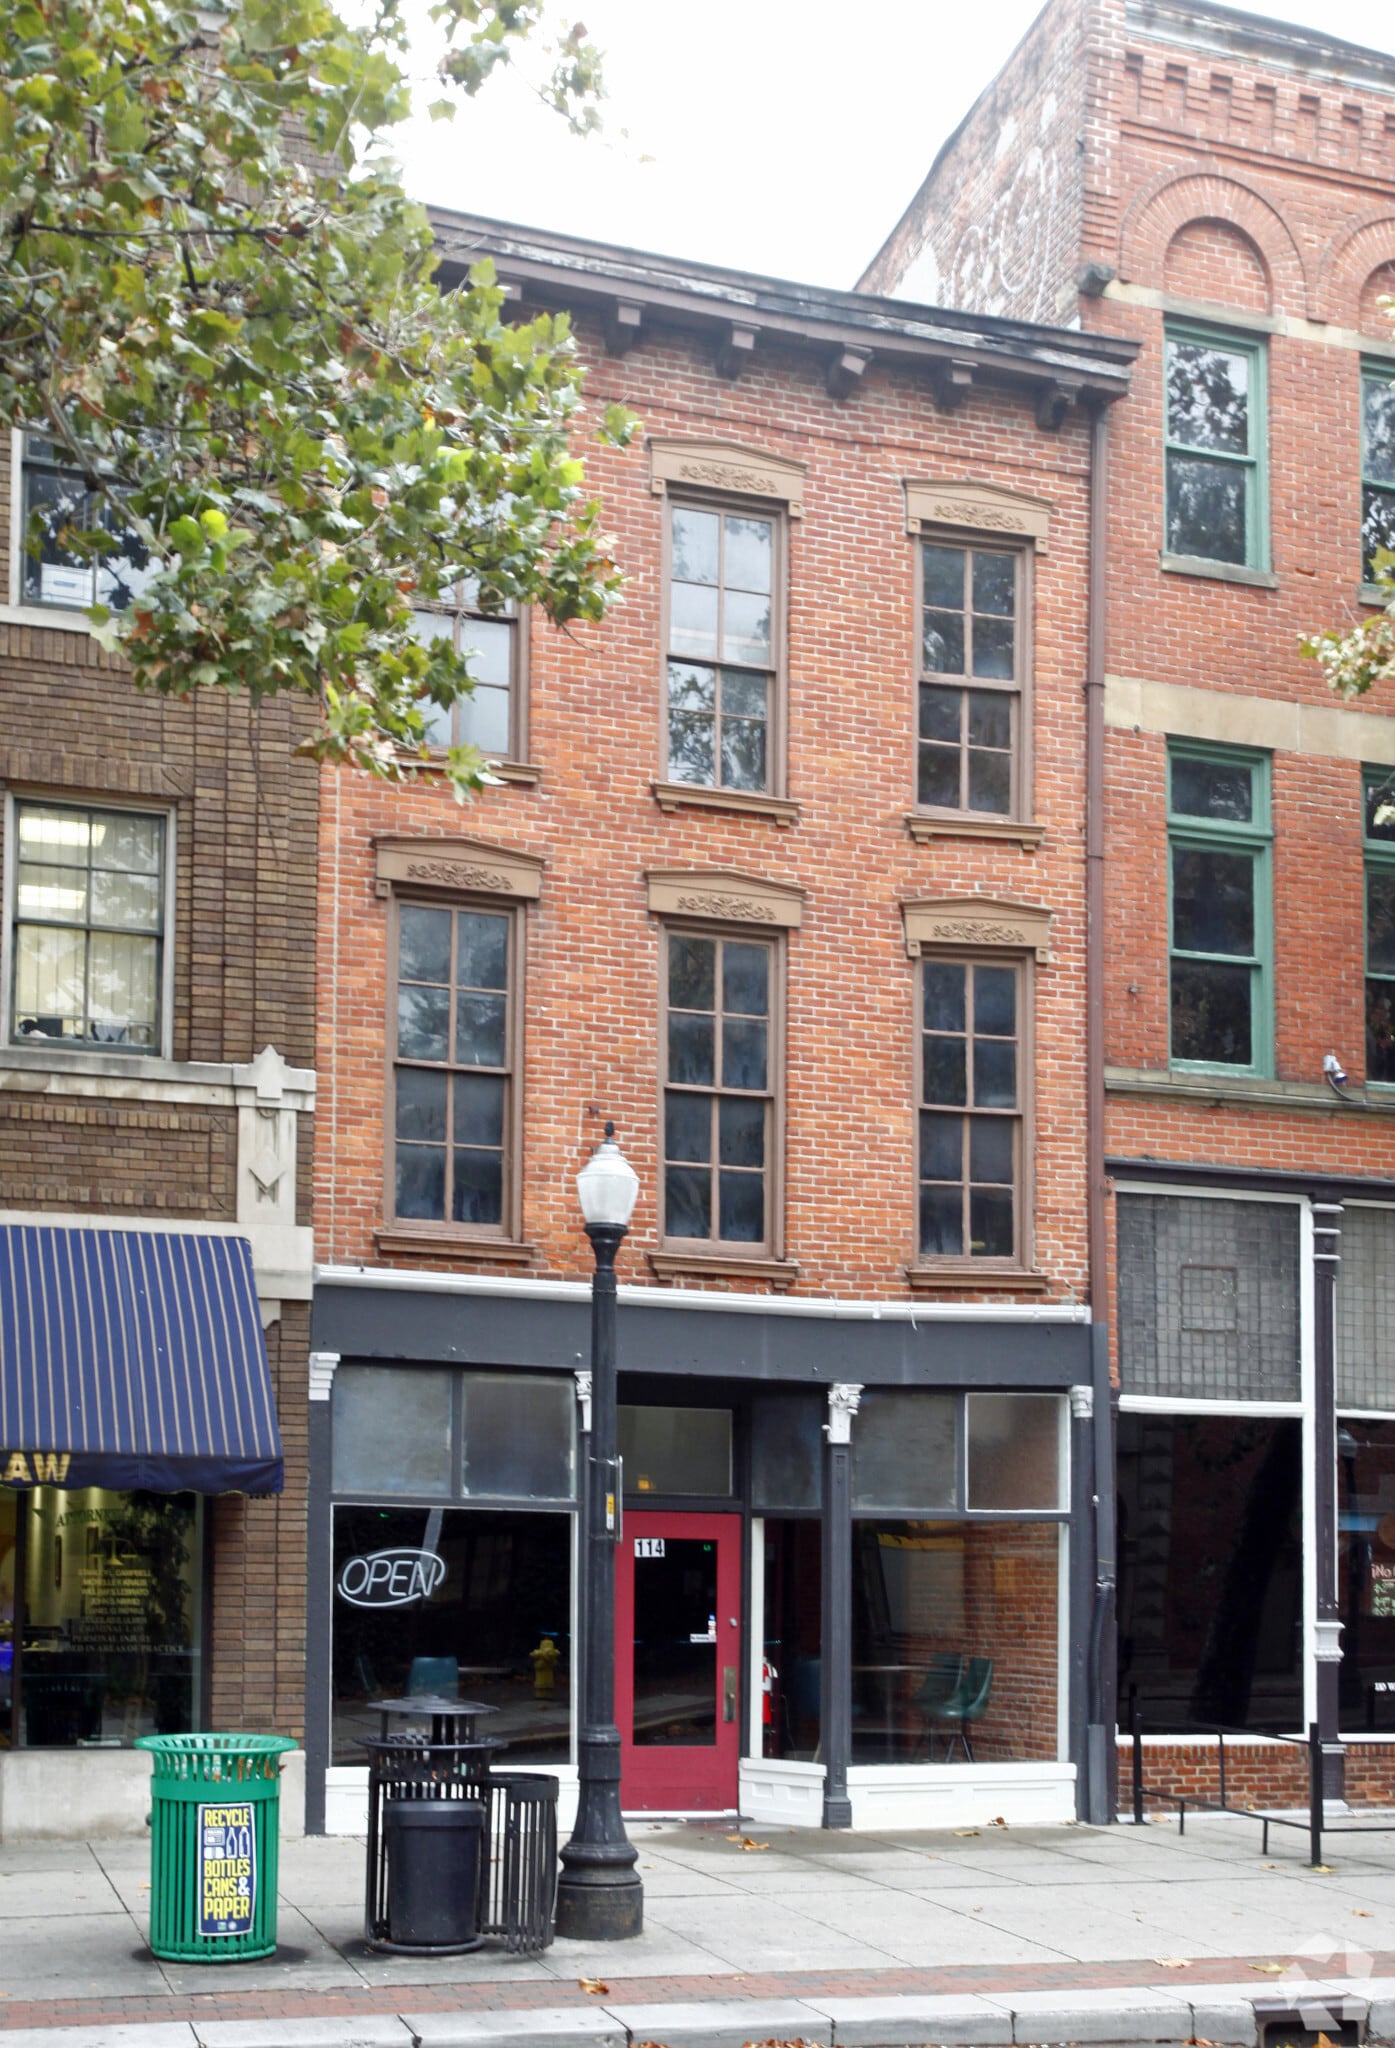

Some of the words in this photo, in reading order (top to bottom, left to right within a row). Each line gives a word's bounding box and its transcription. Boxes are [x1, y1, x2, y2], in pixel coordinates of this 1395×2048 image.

[0, 1452, 71, 1482] AW
[637, 1540, 662, 1555] 114
[342, 1558, 437, 1597] OPEN
[140, 1644, 184, 1653] PRACTICE
[204, 1808, 249, 1827] RECYCLE
[204, 1858, 251, 1878] BOTTLES
[204, 1877, 238, 1897] CANS
[237, 1876, 250, 1896] &
[203, 1896, 250, 1920] PAPER
